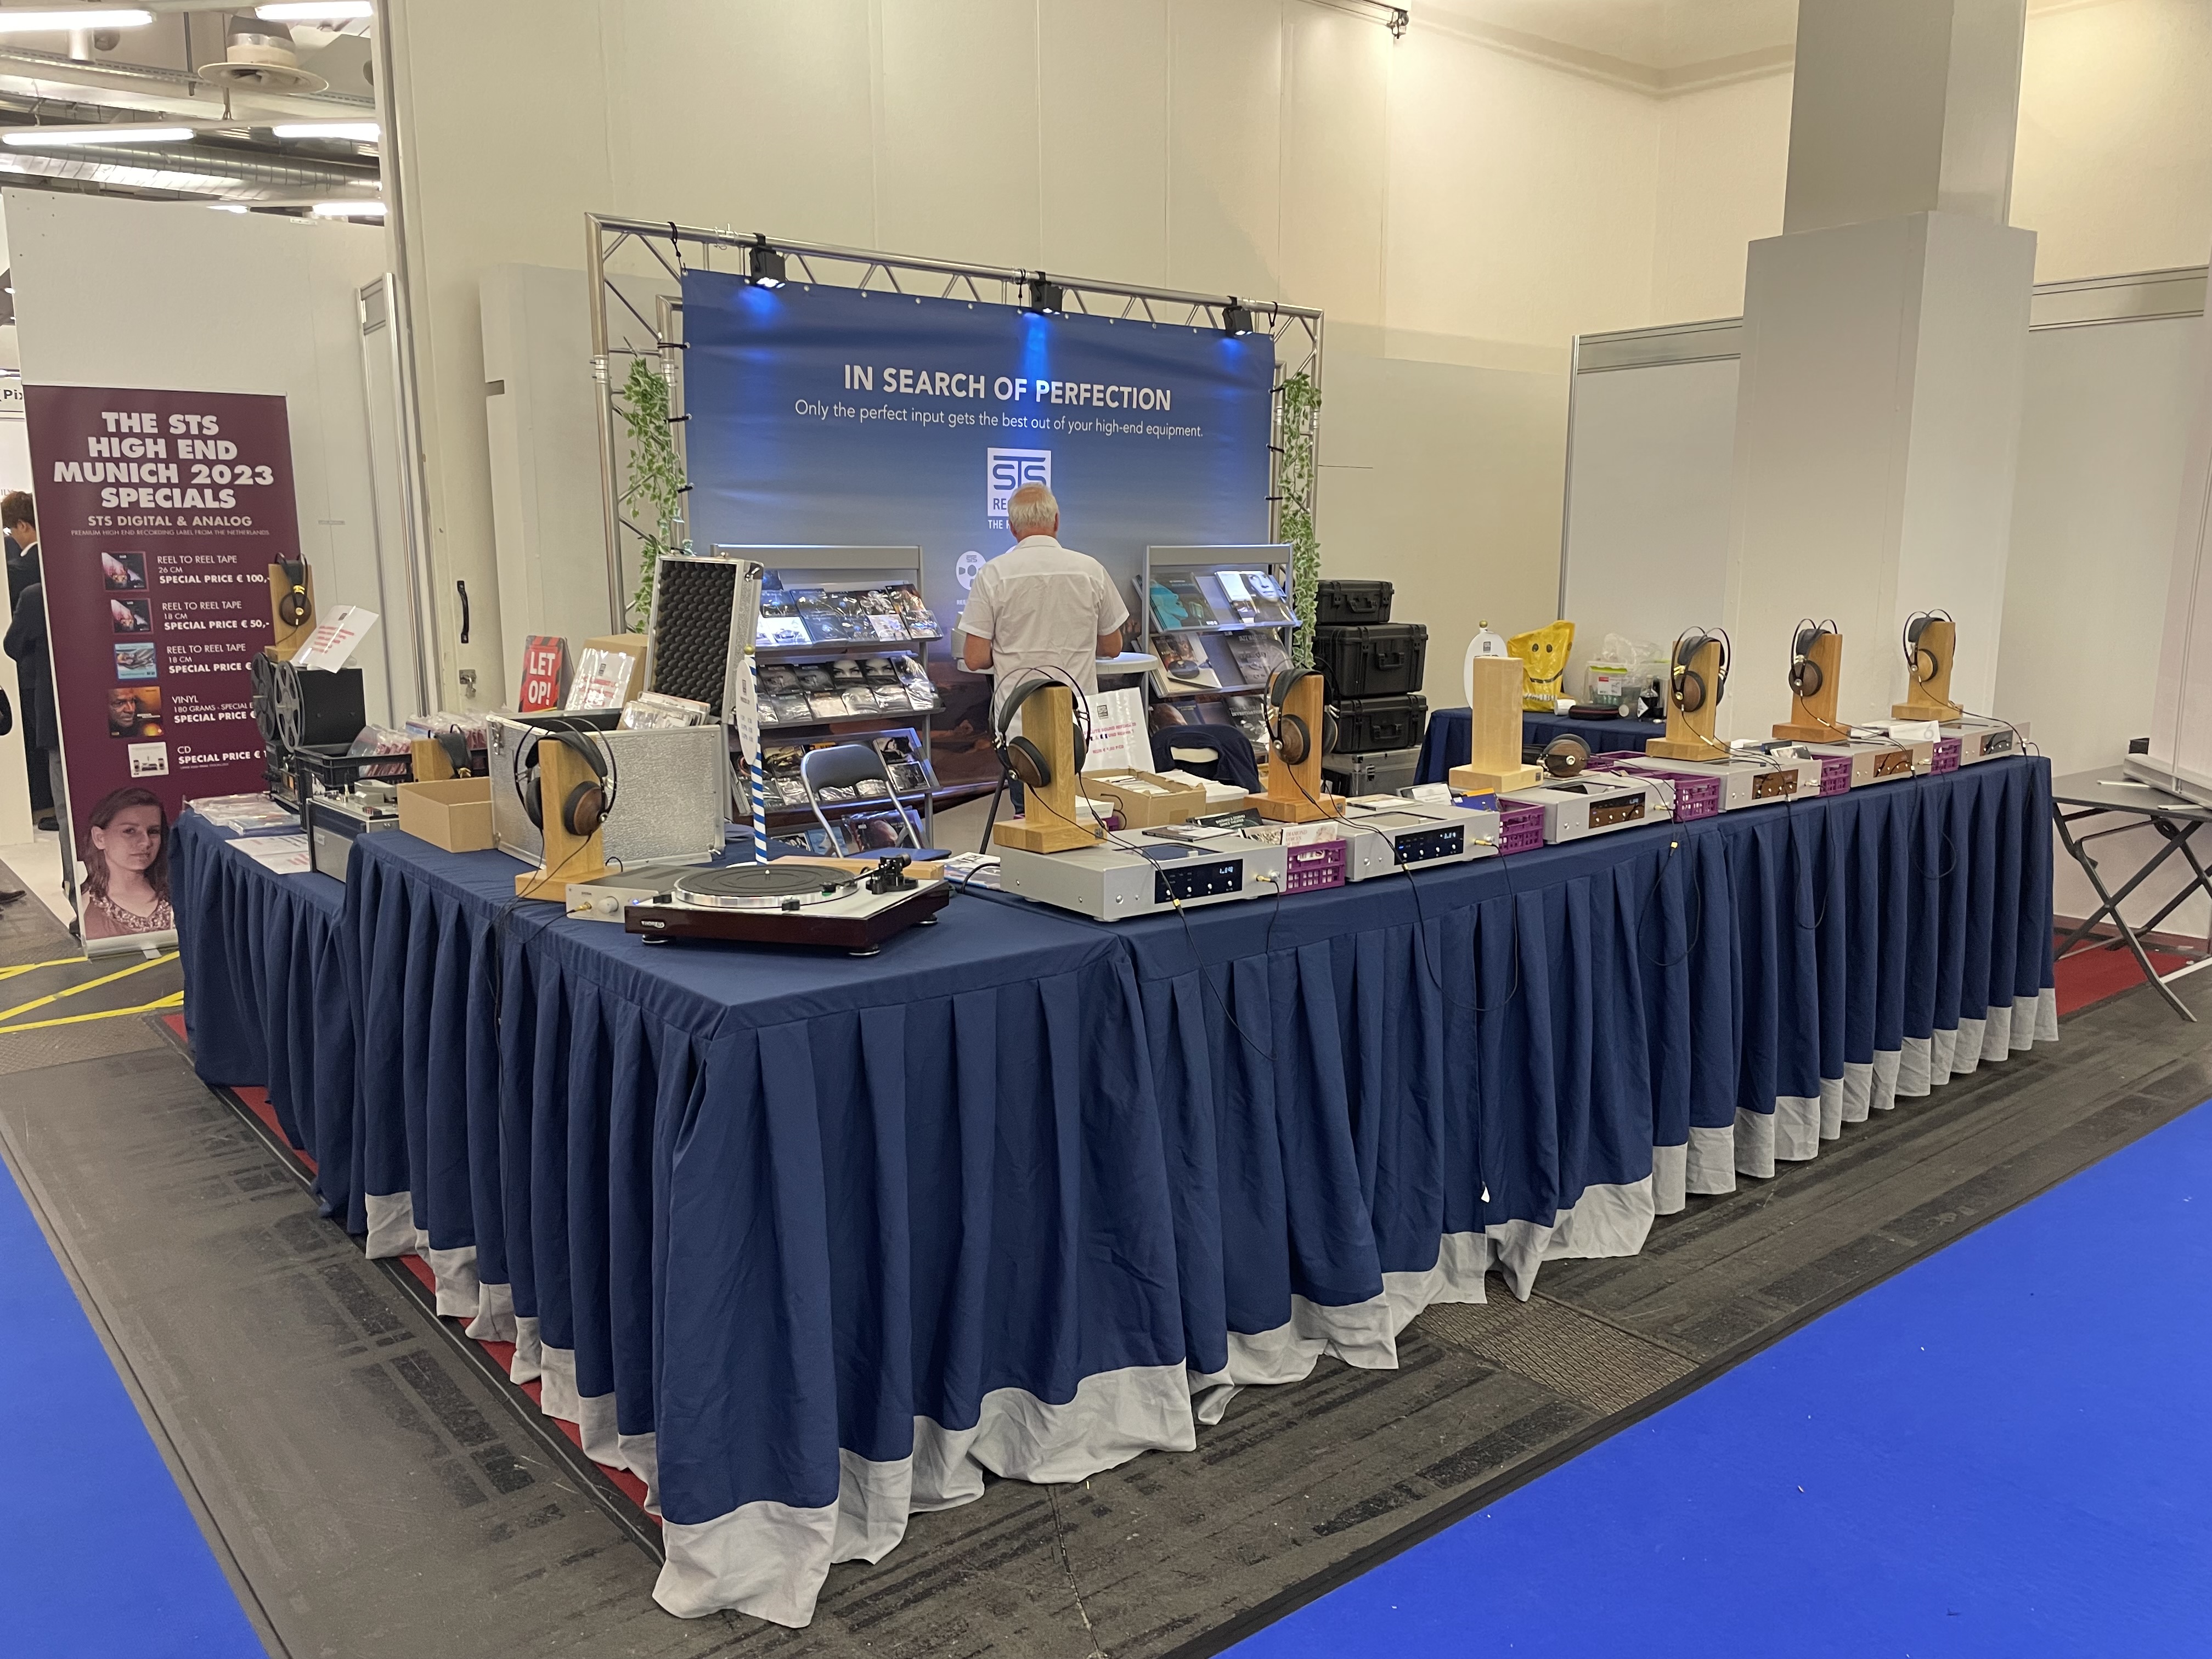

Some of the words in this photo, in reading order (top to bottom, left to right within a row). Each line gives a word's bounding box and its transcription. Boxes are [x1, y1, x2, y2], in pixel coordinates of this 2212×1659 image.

[845, 364, 872, 391] IN
[883, 368, 985, 398] SEARCH
[994, 376, 1028, 400] OF
[1036, 380, 1171, 410] PERFECTION
[101, 411, 159, 433] THE
[169, 414, 219, 436] STS
[795, 399, 828, 420] Only
[833, 402, 855, 417] the
[860, 404, 907, 423] perfect
[912, 408, 944, 427] input
[949, 413, 975, 427] gets
[979, 411, 998, 426] the
[1003, 413, 1028, 428] best
[1031, 416, 1050, 429] out
[1054, 416, 1066, 430] of
[1068, 421, 1092, 434] your
[1096, 418, 1143, 436] high-end
[1146, 423, 1203, 439] equipment.
[88, 437, 167, 458] HIGH
[177, 439, 238, 460] END
[54, 461, 179, 483] MUNICH
[190, 464, 274, 485] 2023
[992, 455, 1046, 490] STS
[101, 487, 236, 509] SPECIALS
[88, 516, 112, 526] STS
[117, 516, 172, 527] DIGITAL
[177, 516, 187, 527] &
[192, 516, 252, 527] ANALOG
[988, 520, 1003, 529] THE
[157, 556, 177, 564] REEL
[179, 555, 193, 563] TO
[195, 555, 215, 563] REEL
[217, 555, 238, 563] TAPE
[160, 575, 201, 584] SPECIAL
[204, 575, 233, 583] PRICE
[236, 574, 243, 583] €
[162, 602, 182, 611] REEL
[184, 602, 198, 610] TO
[200, 601, 219, 610] REEL
[222, 601, 242, 609] TAPE
[164, 621, 206, 630] SPECIAL
[209, 620, 238, 629] PRICE
[241, 620, 247, 628] €
[250, 619, 269, 630] 50,-
[167, 646, 187, 654] REEL
[225, 644, 246, 652] TAPE
[169, 664, 210, 674] SPECIAL
[213, 663, 242, 672] PRICE
[529, 651, 556, 676] LET
[528, 680, 551, 706] OP!
[172, 695, 199, 704] VINYL
[174, 714, 216, 723] SPECIAL
[218, 712, 246, 720] PRICE
[177, 746, 191, 754] CD
[178, 754, 219, 764] SPECIAL
[222, 752, 250, 761] PRICE
